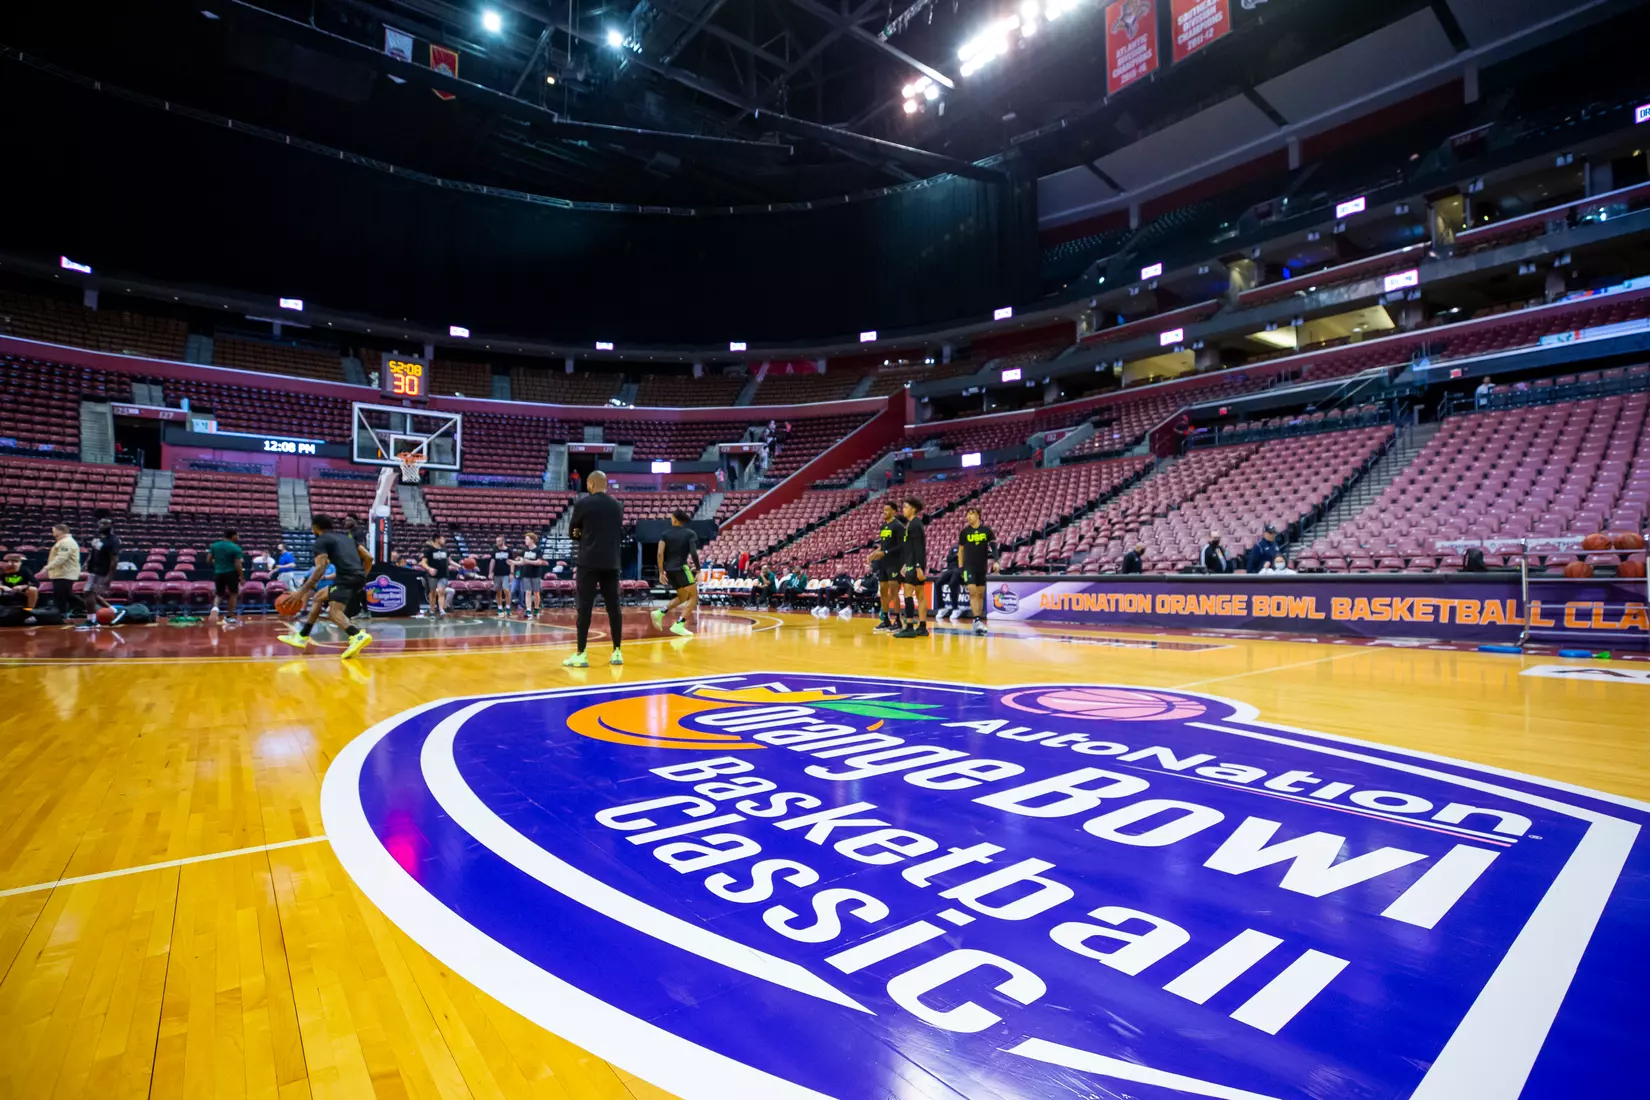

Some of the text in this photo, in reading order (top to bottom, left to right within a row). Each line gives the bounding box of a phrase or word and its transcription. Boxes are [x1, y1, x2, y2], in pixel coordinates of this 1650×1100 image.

[1177, 10, 1223, 45] CHAMPIONS
[1182, 4, 1217, 32] DIVISION
[1112, 48, 1152, 79] CHAMPIONS
[393, 374, 419, 396] 30
[263, 440, 316, 455] 12:08 PM
[1039, 593, 1152, 613] AUTONATION
[1155, 593, 1248, 616] ORANGE
[1251, 595, 1326, 620] BOWL
[1330, 597, 1556, 627] BASKETBALL
[693, 705, 1026, 791] Orange
[940, 719, 1533, 837] AutoNation
[648, 756, 1350, 1035] Basketball
[595, 795, 1047, 1033] Classic
